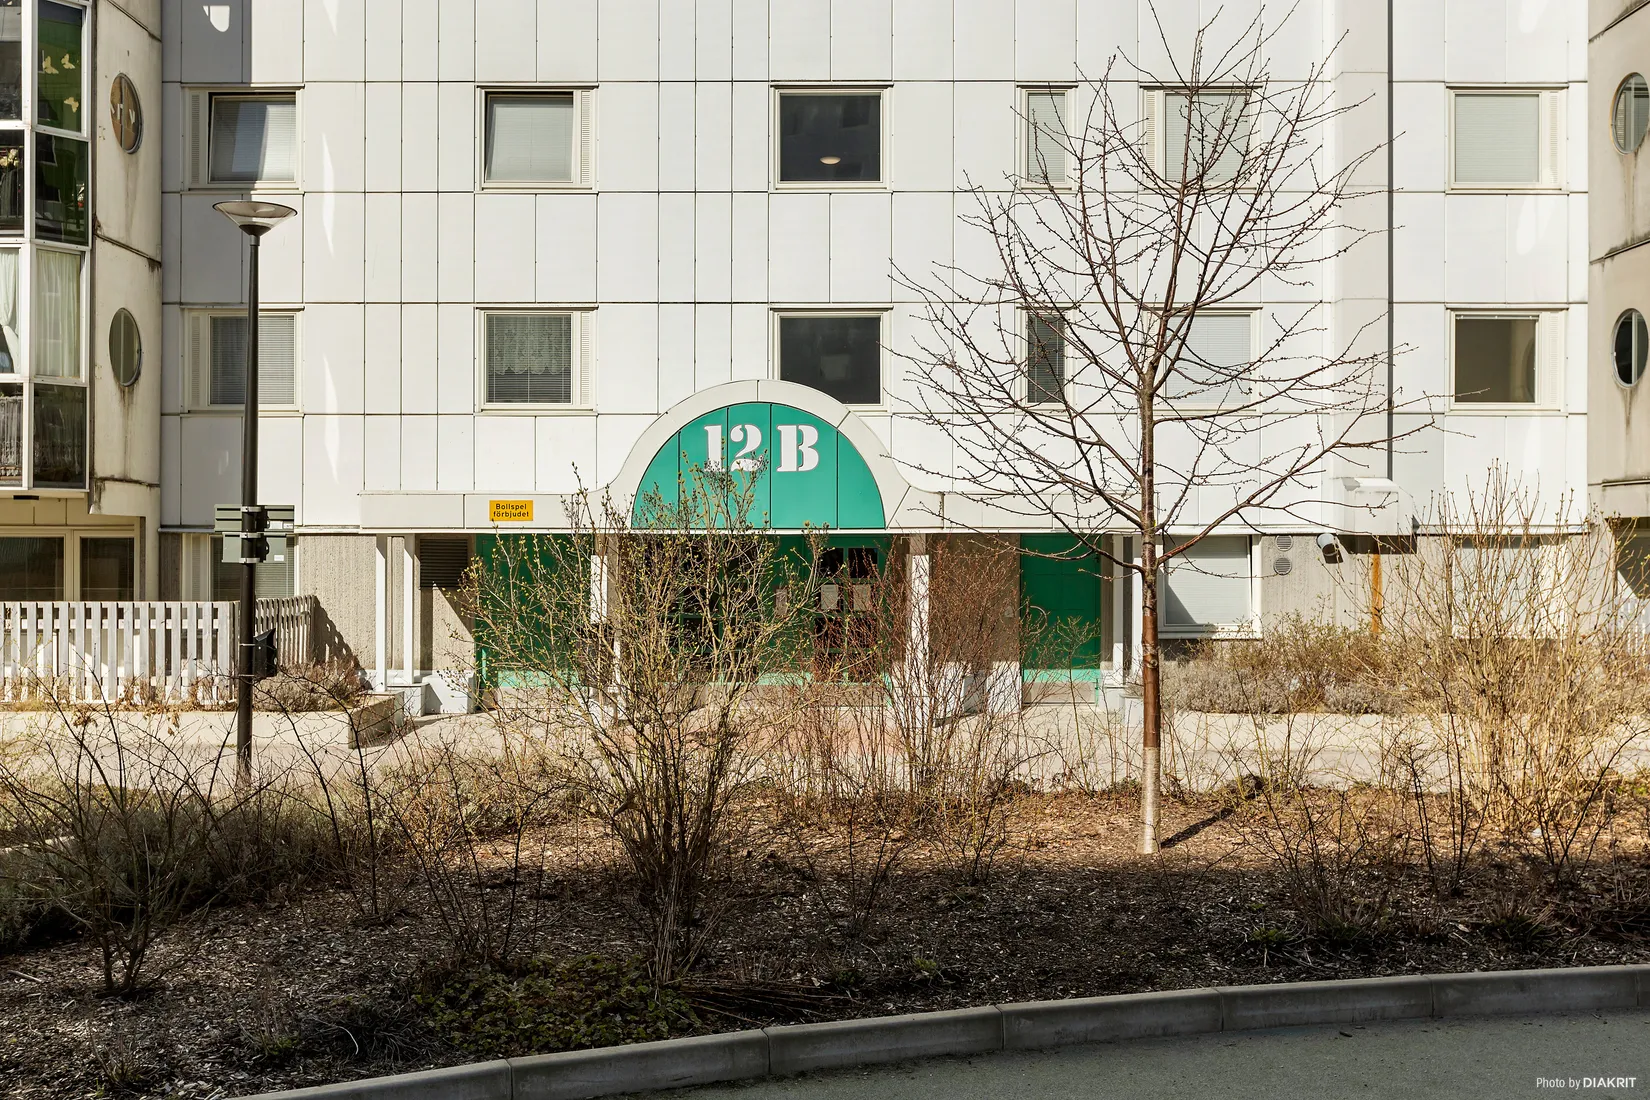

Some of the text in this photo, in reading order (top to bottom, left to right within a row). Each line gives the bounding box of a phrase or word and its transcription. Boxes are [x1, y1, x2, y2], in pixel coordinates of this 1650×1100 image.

[703, 424, 819, 472] 12 B
[495, 503, 527, 511] Bollspel
[493, 510, 529, 519] förbjudet
